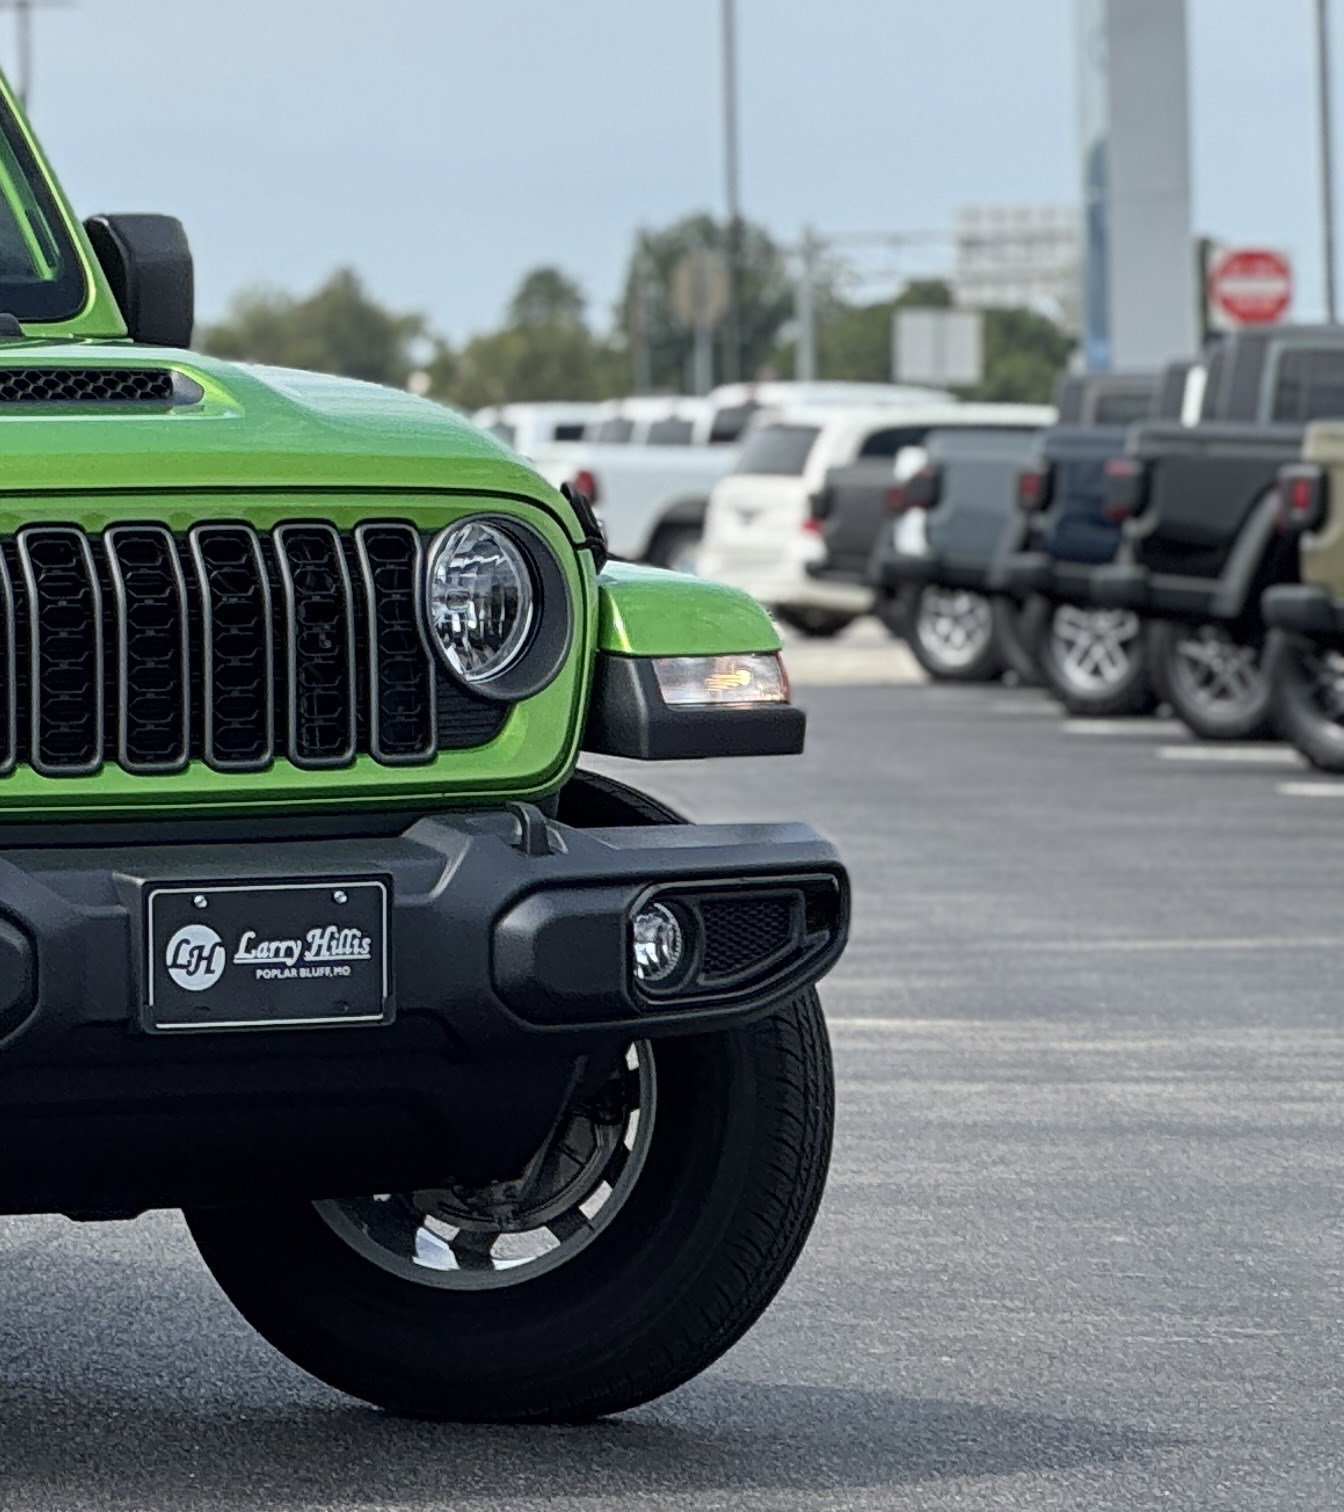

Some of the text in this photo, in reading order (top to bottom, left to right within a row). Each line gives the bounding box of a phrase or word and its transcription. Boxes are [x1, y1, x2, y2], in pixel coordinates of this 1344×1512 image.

[232, 924, 372, 967] Larry Hillis
[256, 965, 351, 980] POPLAR BLUFF, MO
